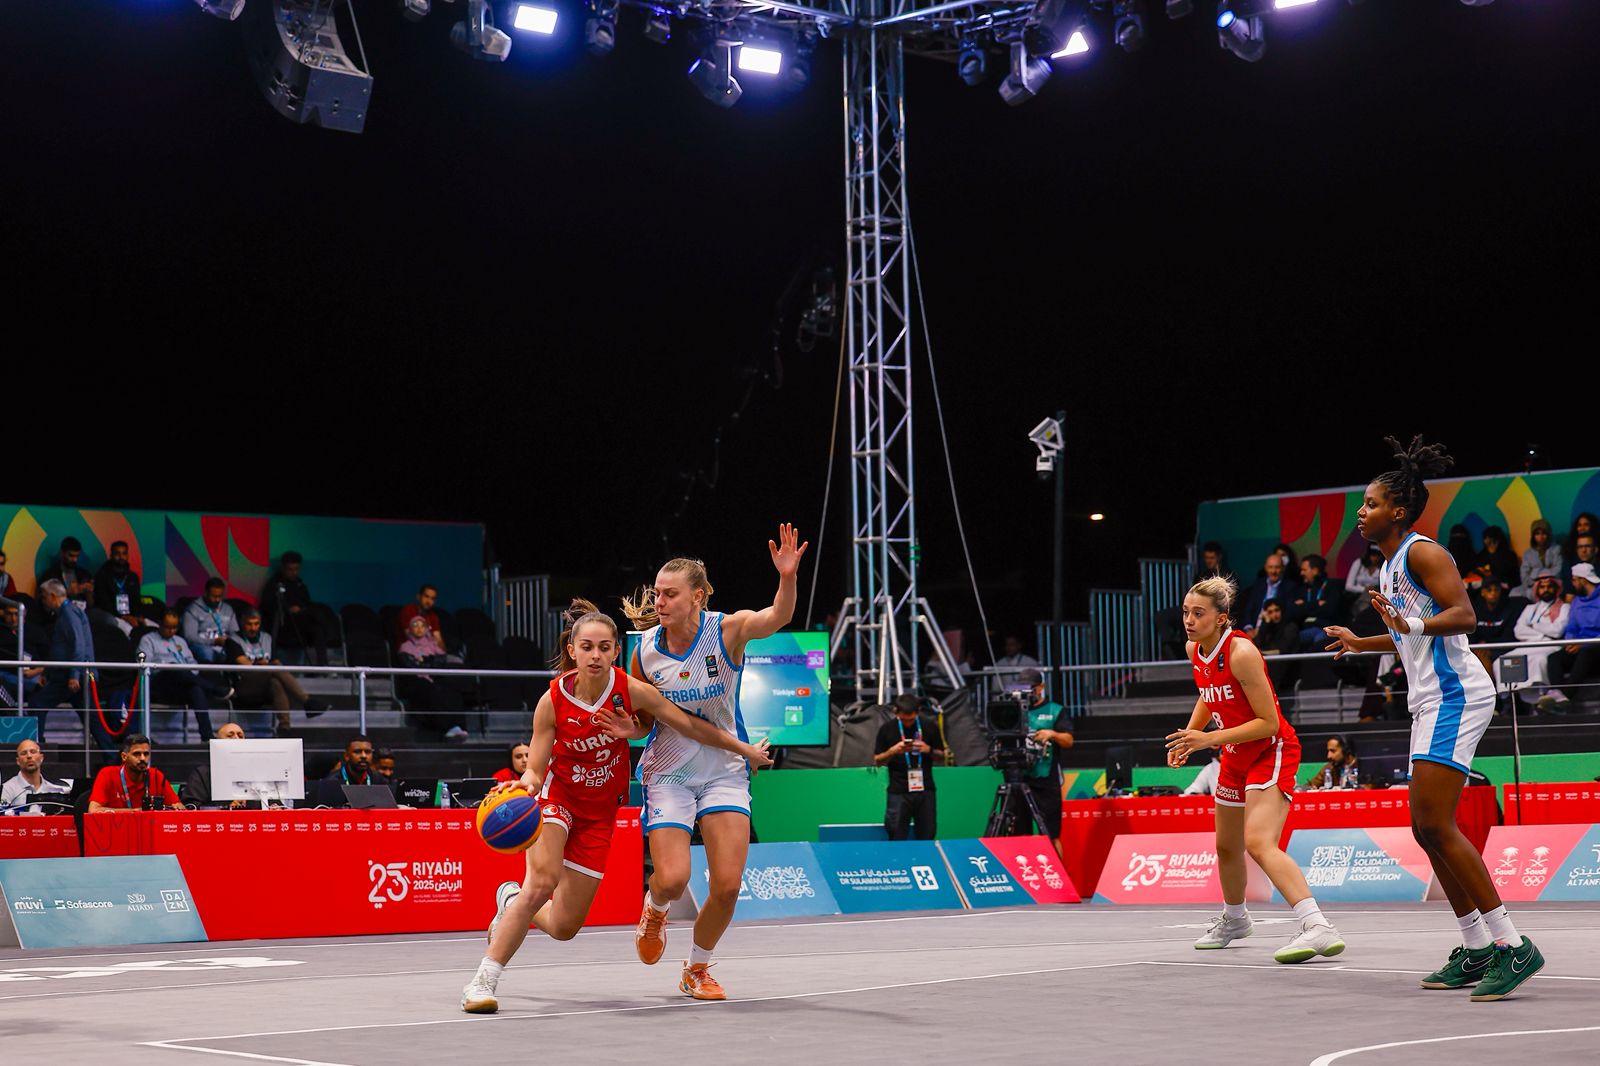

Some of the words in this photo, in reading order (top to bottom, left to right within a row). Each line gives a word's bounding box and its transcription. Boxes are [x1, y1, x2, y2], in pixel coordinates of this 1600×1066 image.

[1212, 712, 1225, 729] 8
[1168, 851, 1218, 868] RIYADH
[1354, 850, 1387, 858] ISLAMIC
[1353, 858, 1402, 867] SOLIDARITY
[412, 858, 463, 879] RIYADH
[1492, 867, 1517, 876] Saudi
[1523, 867, 1548, 875] Saudi
[1348, 873, 1402, 881] ASSOCIATION
[434, 880, 463, 892] الرياض
[14, 898, 44, 910] muvi
[66, 899, 114, 910] Sofascore
